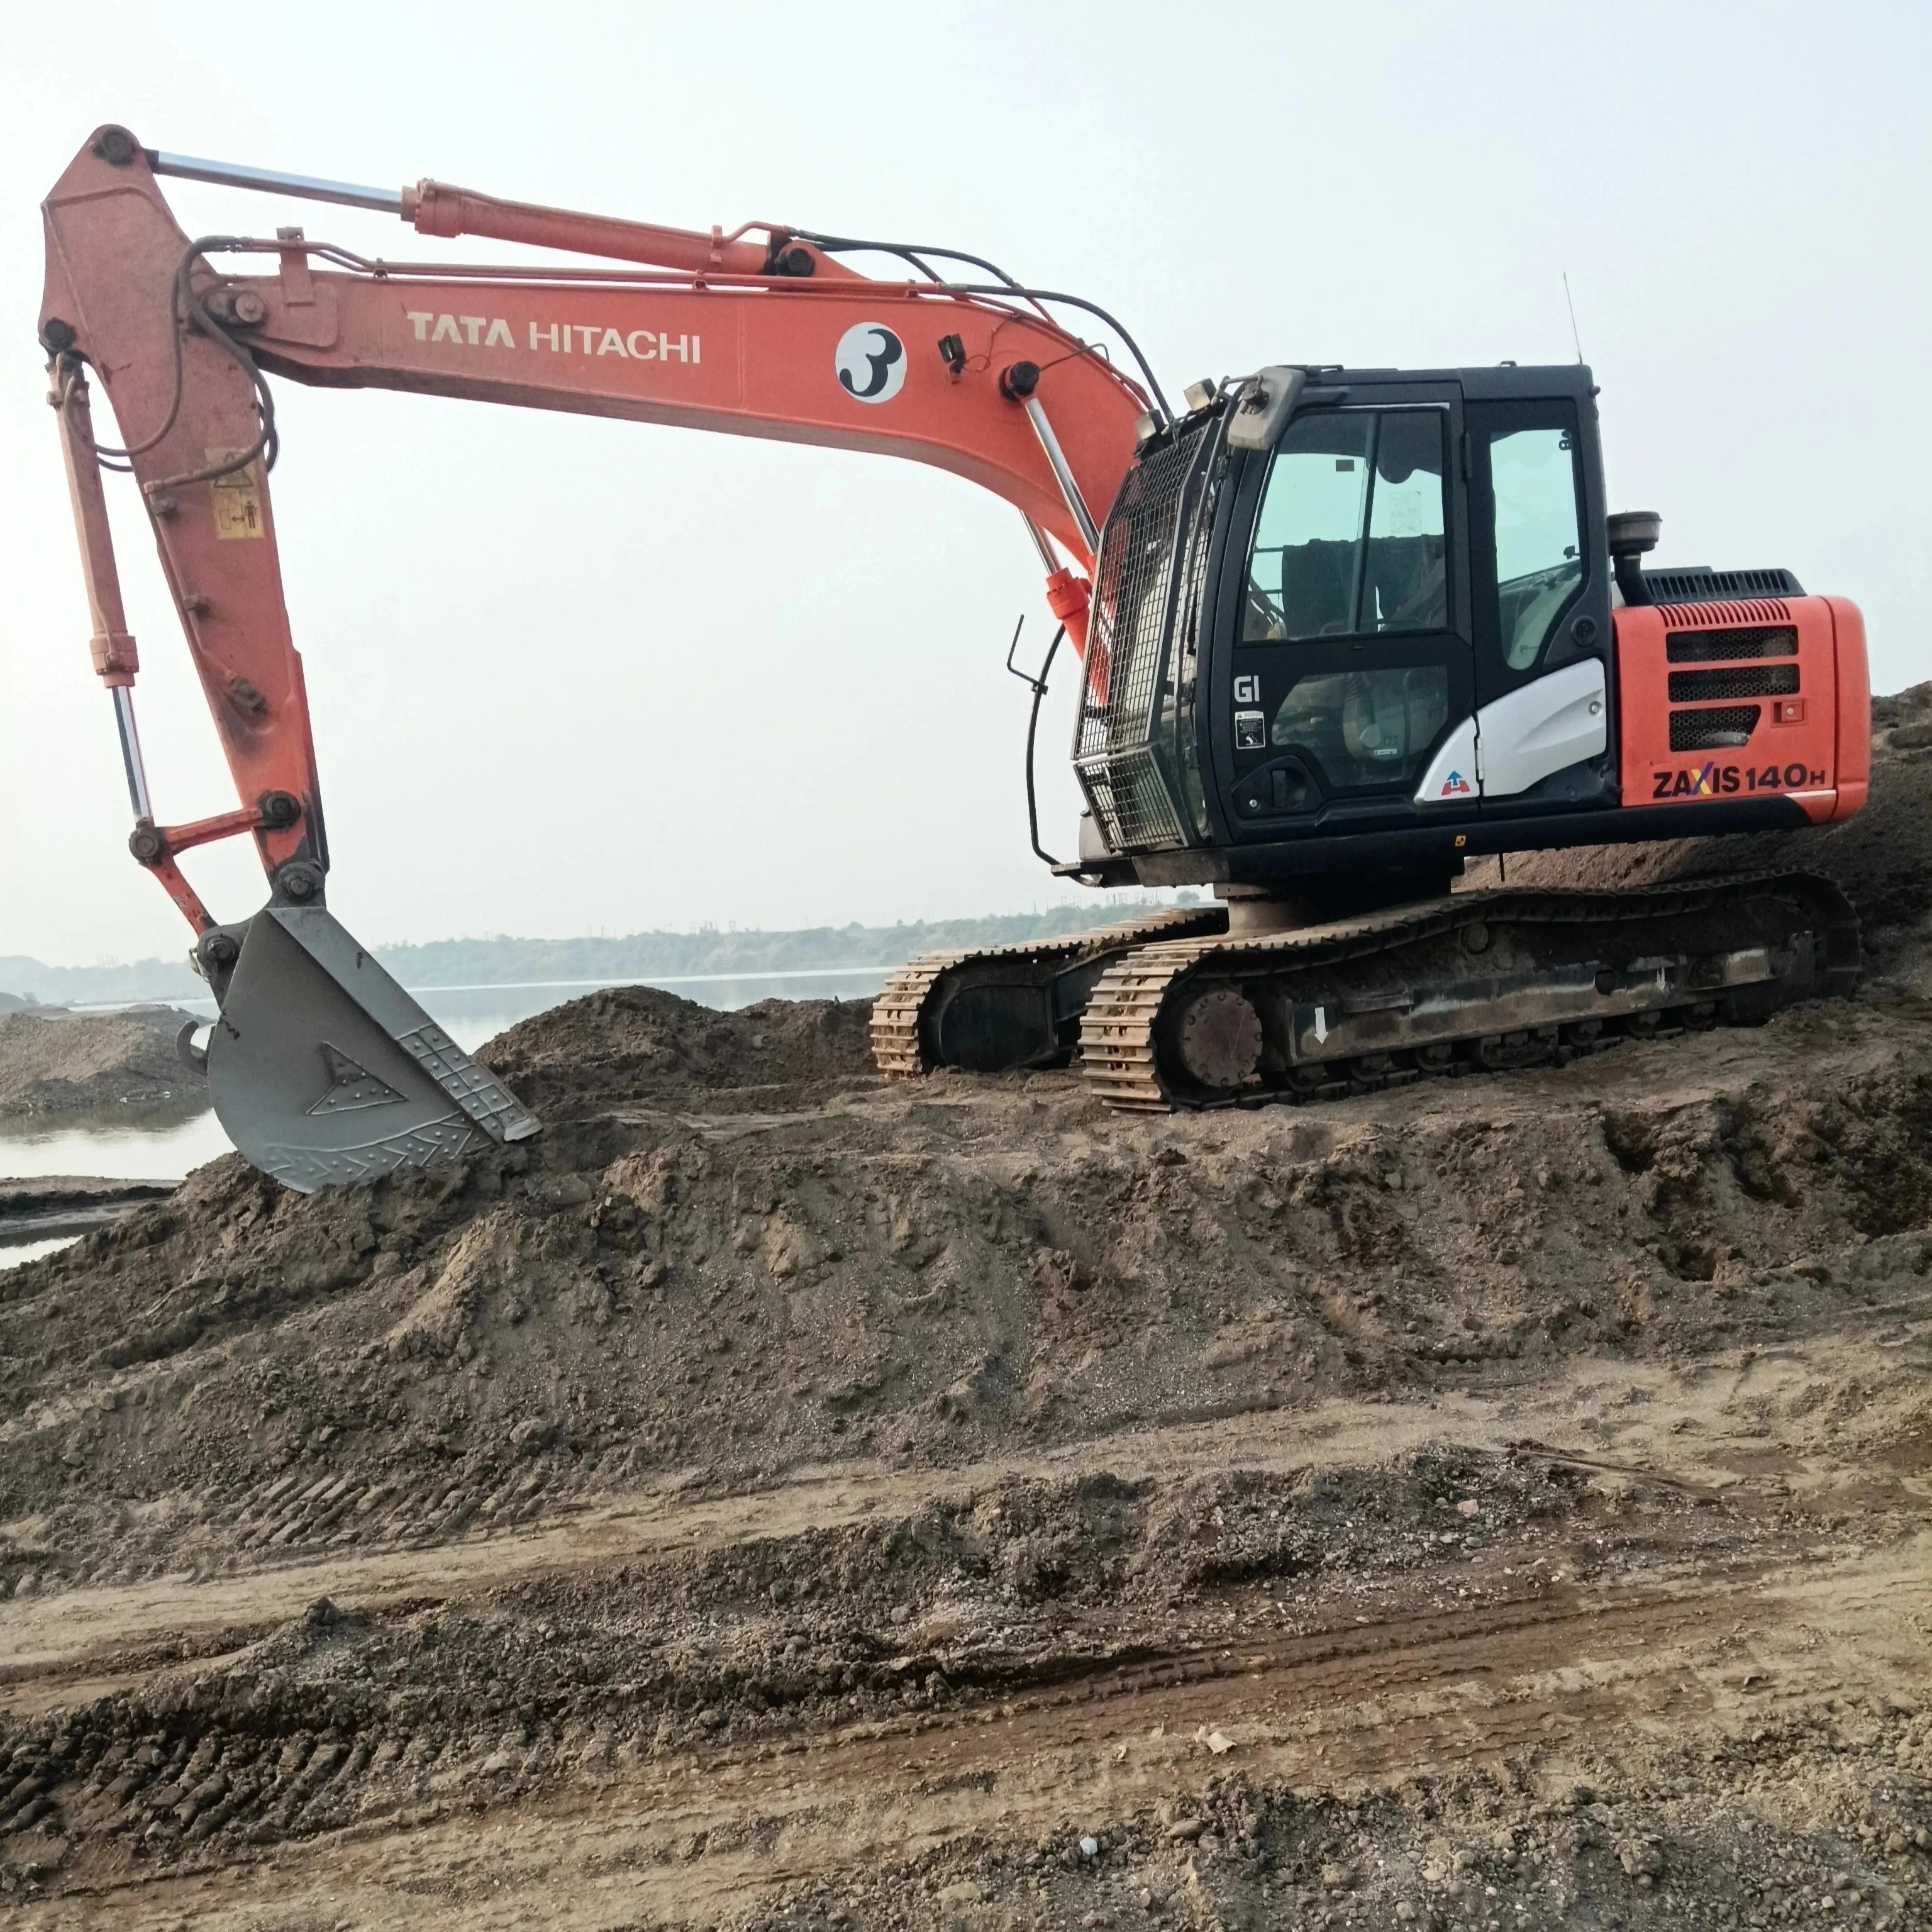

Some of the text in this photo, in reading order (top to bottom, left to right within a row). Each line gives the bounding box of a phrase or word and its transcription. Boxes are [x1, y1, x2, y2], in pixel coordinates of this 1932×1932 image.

[407, 311, 701, 364] TATA HITACHI
[839, 328, 902, 397] 3
[1653, 762, 1740, 798] ZAXIS
